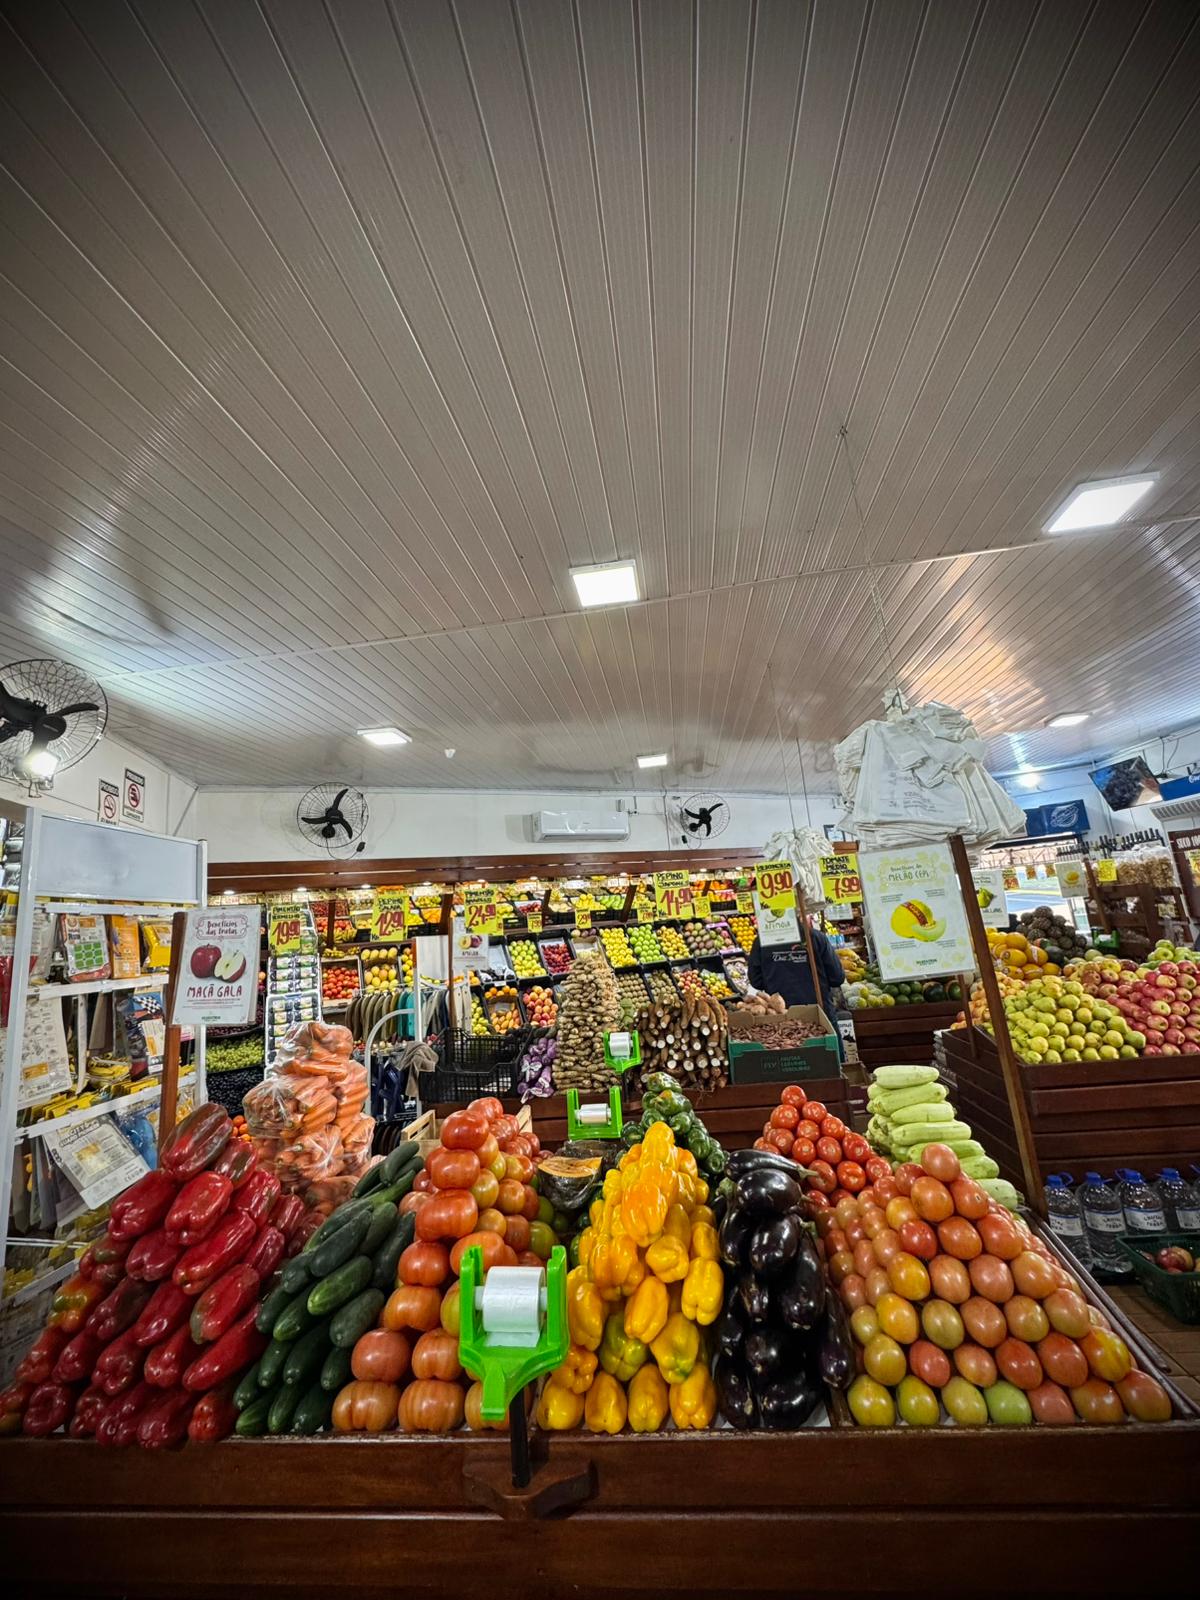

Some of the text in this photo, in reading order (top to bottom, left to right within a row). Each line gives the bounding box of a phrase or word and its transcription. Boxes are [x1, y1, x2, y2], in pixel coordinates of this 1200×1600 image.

[820, 856, 849, 864] TOMATE
[889, 871, 913, 881] MELÃO
[217, 985, 242, 998] GALA
